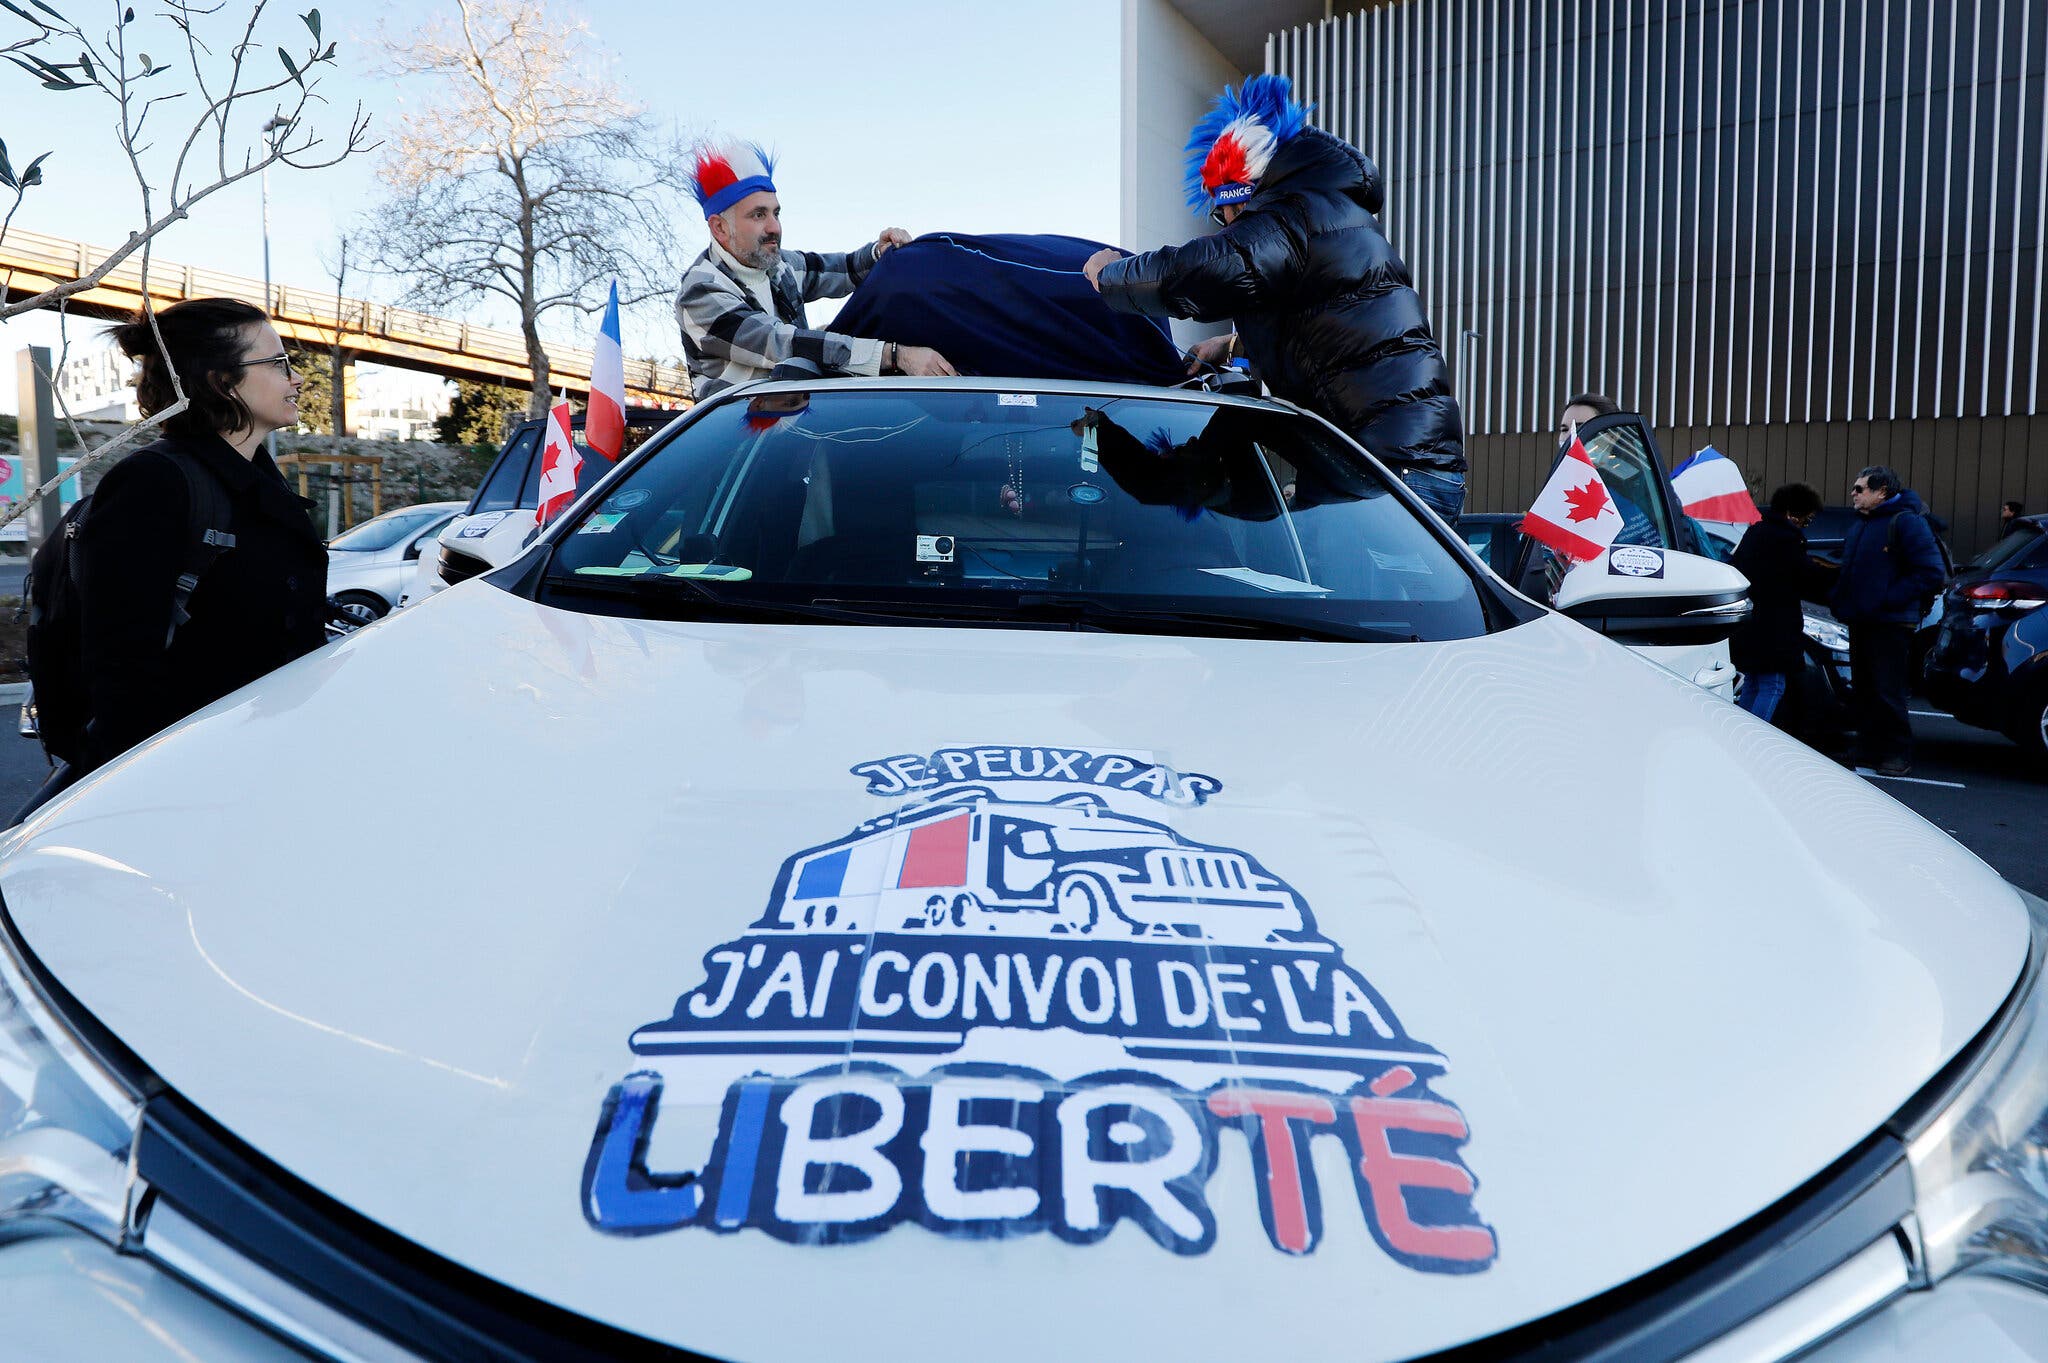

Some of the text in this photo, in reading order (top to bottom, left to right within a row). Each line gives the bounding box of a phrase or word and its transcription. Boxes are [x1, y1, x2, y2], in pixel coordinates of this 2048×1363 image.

[1220, 186, 1252, 199] FRANCE
[858, 748, 1213, 804] JE PEUX PAS
[689, 943, 839, 1019] J'AI
[859, 950, 1138, 1028] CONVOI
[1157, 960, 1262, 1032] DE
[591, 1067, 1497, 1264] LIBERTÉ
